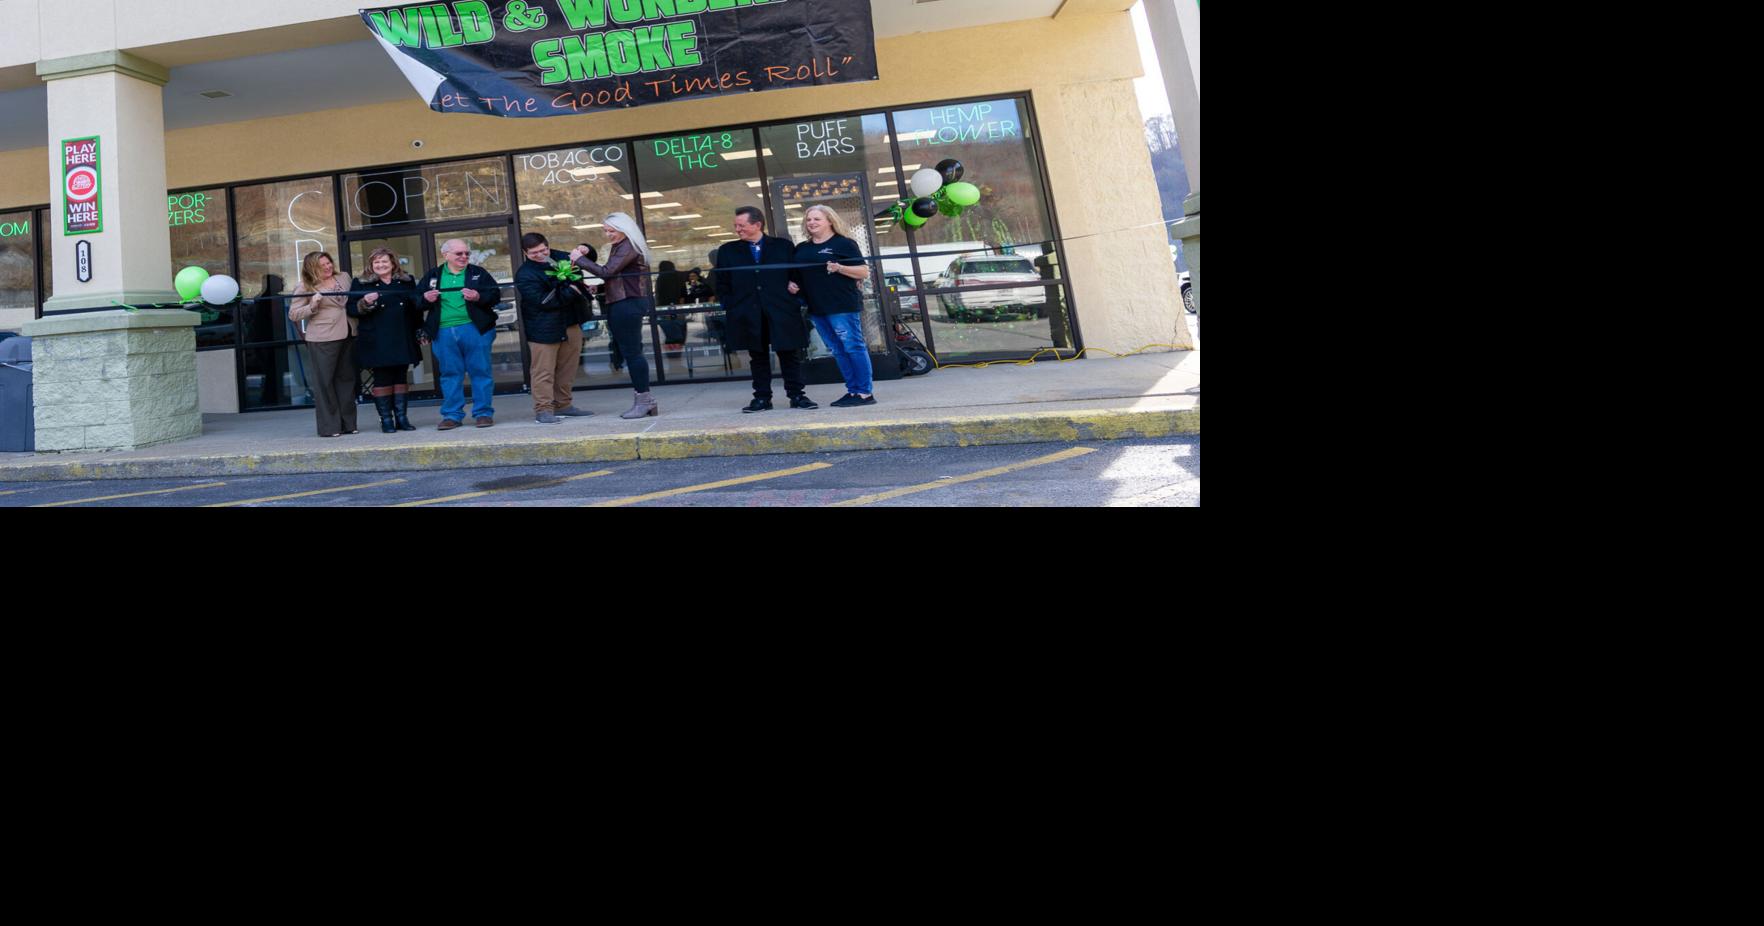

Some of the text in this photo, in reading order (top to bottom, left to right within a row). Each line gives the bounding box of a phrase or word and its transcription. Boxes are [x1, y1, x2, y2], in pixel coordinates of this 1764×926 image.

[368, 0, 496, 49] WILD
[502, 0, 548, 32] &
[531, 20, 702, 85] SMOKE
[430, 92, 469, 107] et
[479, 95, 538, 113] The
[551, 82, 633, 110] Good
[645, 69, 752, 97] Times
[930, 104, 992, 125] HEMP
[796, 119, 848, 141] PUFF
[65, 143, 97, 155] PLAY
[654, 133, 733, 157] DELTA-8
[796, 137, 855, 159] BARS
[66, 152, 97, 165] HERE
[518, 146, 623, 172] TOBACCO
[674, 152, 719, 171] THC
[354, 167, 500, 218] OPEN
[67, 211, 99, 223] HERE
[69, 201, 96, 214] WIN
